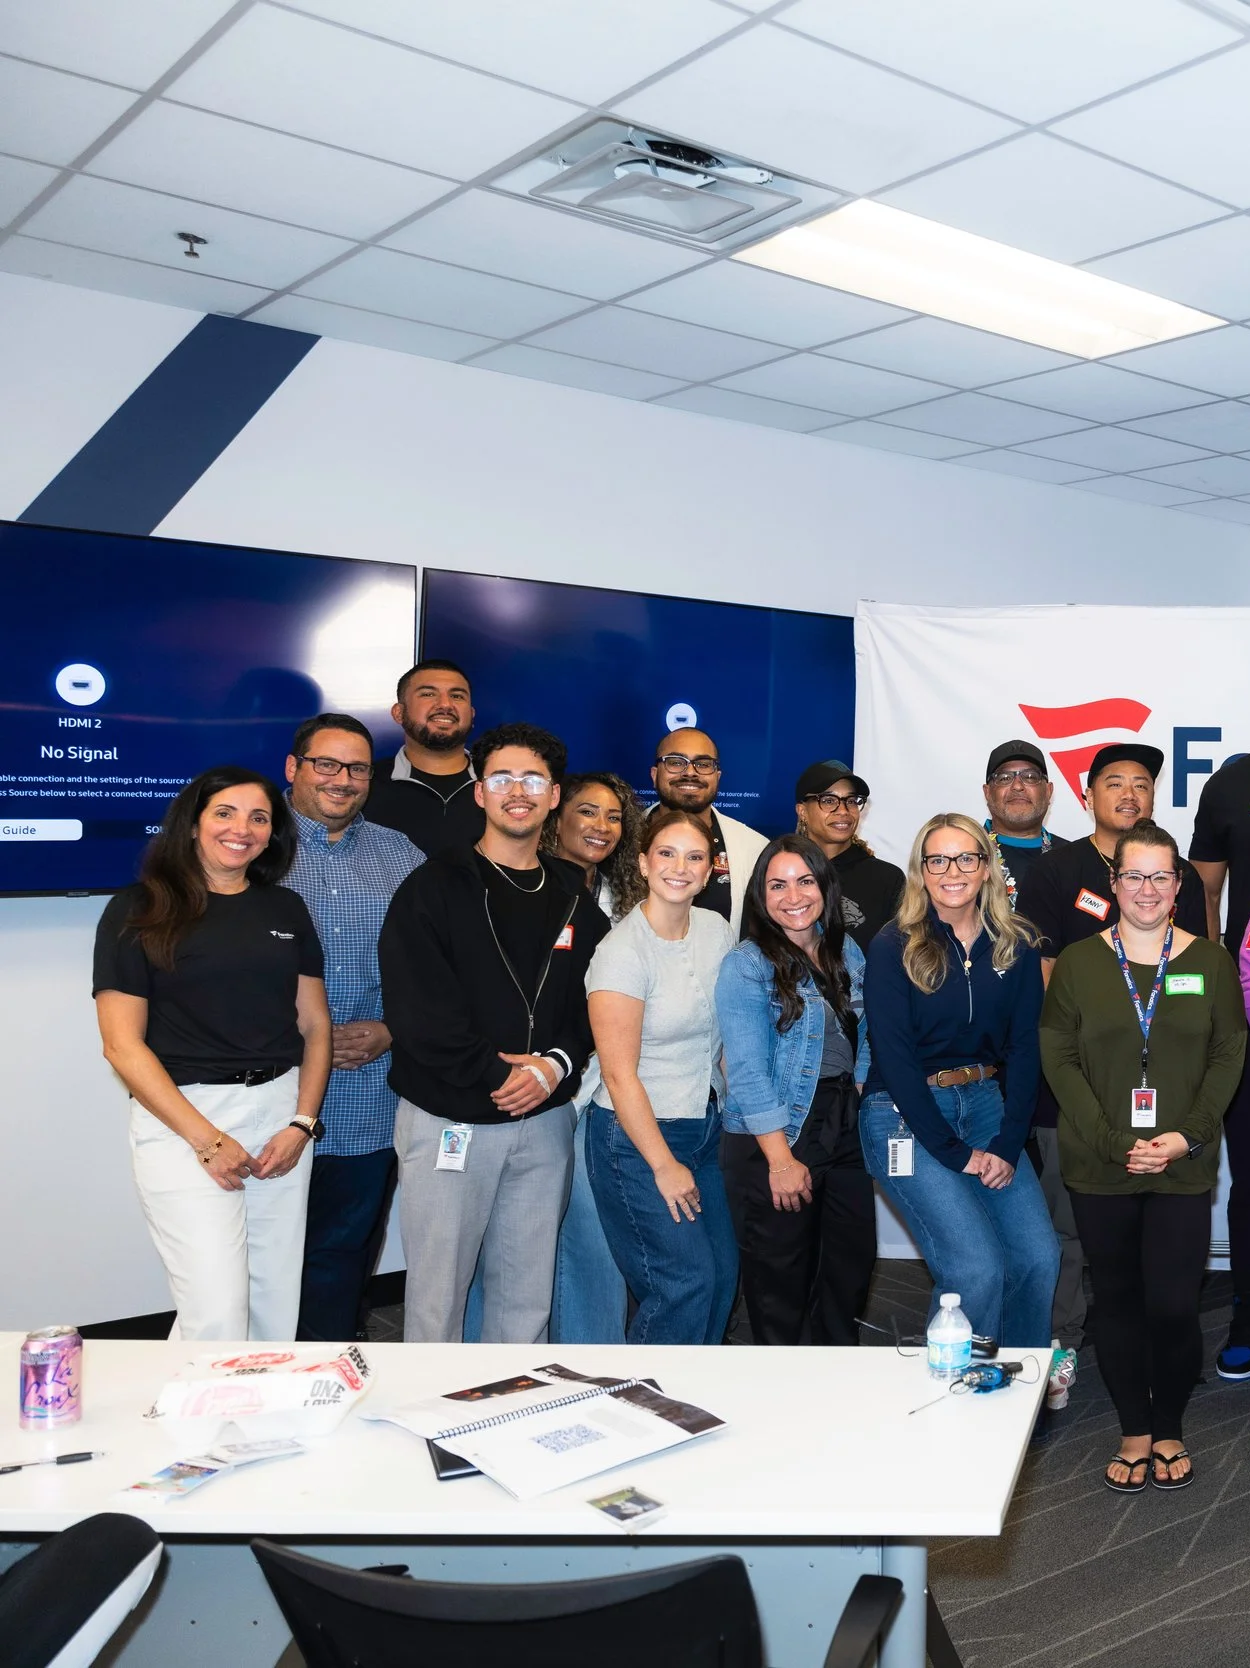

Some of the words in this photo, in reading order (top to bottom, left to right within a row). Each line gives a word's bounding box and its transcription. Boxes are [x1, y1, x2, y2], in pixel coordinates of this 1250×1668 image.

[58, 717, 92, 728] HDMI
[94, 718, 102, 729] 2
[40, 745, 64, 759] No
[67, 746, 119, 763] Signal
[18, 775, 65, 783] connection
[66, 775, 82, 783] and
[84, 775, 98, 783] the
[100, 776, 133, 785] settings
[134, 776, 143, 784] of
[144, 776, 157, 784] the
[159, 777, 185, 785] source
[8, 788, 38, 797] Source
[40, 789, 66, 797] below
[67, 789, 77, 797] to
[78, 789, 103, 797] select
[111, 790, 153, 798] connected
[2, 825, 37, 835] Guide
[1164, 926, 1173, 945] Fanatics
[1113, 939, 1123, 959] Fanatics
[1156, 956, 1167, 978] Fanatics
[1122, 969, 1133, 990] Fanatics
[1147, 989, 1158, 1010] Fanatics
[1133, 1000, 1144, 1022] Fanatics
[310, 1380, 346, 1399] ONE
